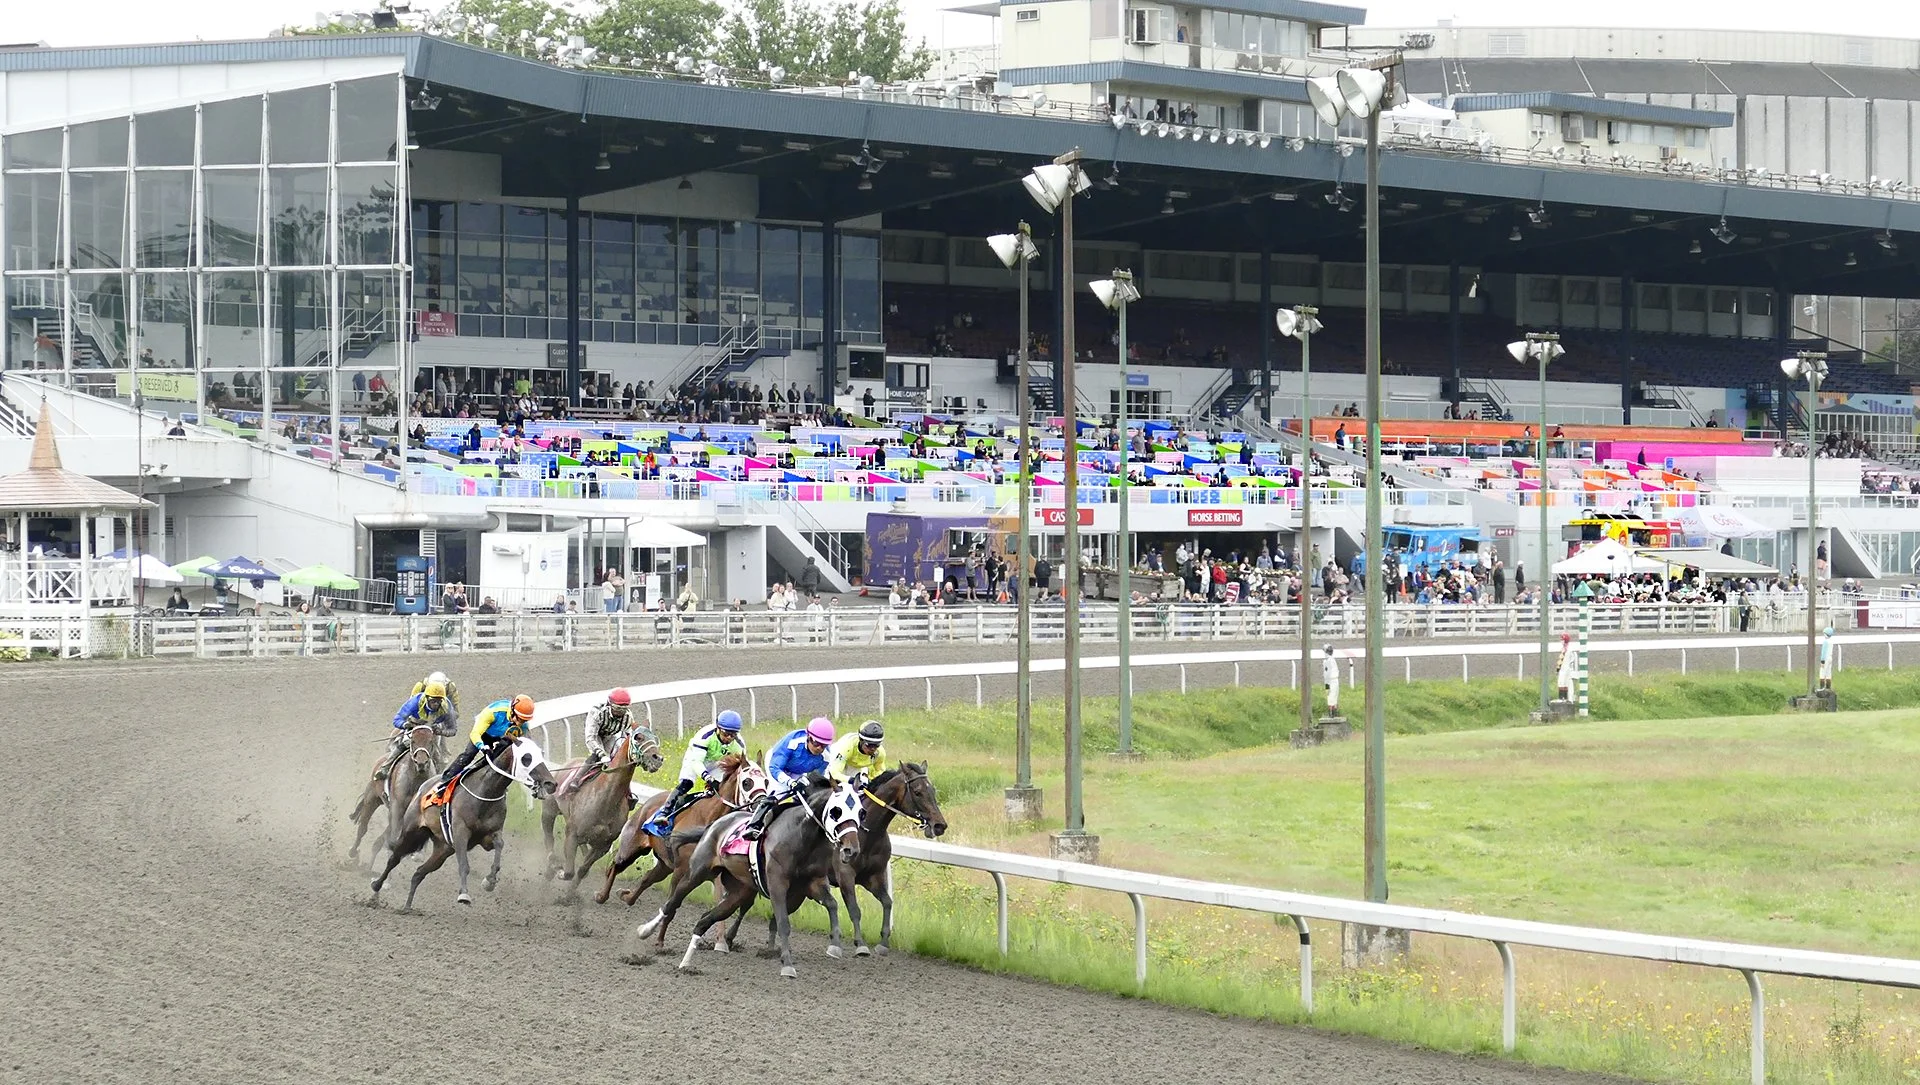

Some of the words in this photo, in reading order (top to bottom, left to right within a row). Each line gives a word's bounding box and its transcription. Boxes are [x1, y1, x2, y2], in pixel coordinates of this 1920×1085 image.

[144, 377, 172, 392] RESERVED
[889, 390, 902, 398] HOME
[1050, 511, 1081, 523] CASO
[1191, 512, 1214, 523] HORSE
[1214, 512, 1241, 523] BETTING
[227, 565, 265, 575] Coors
